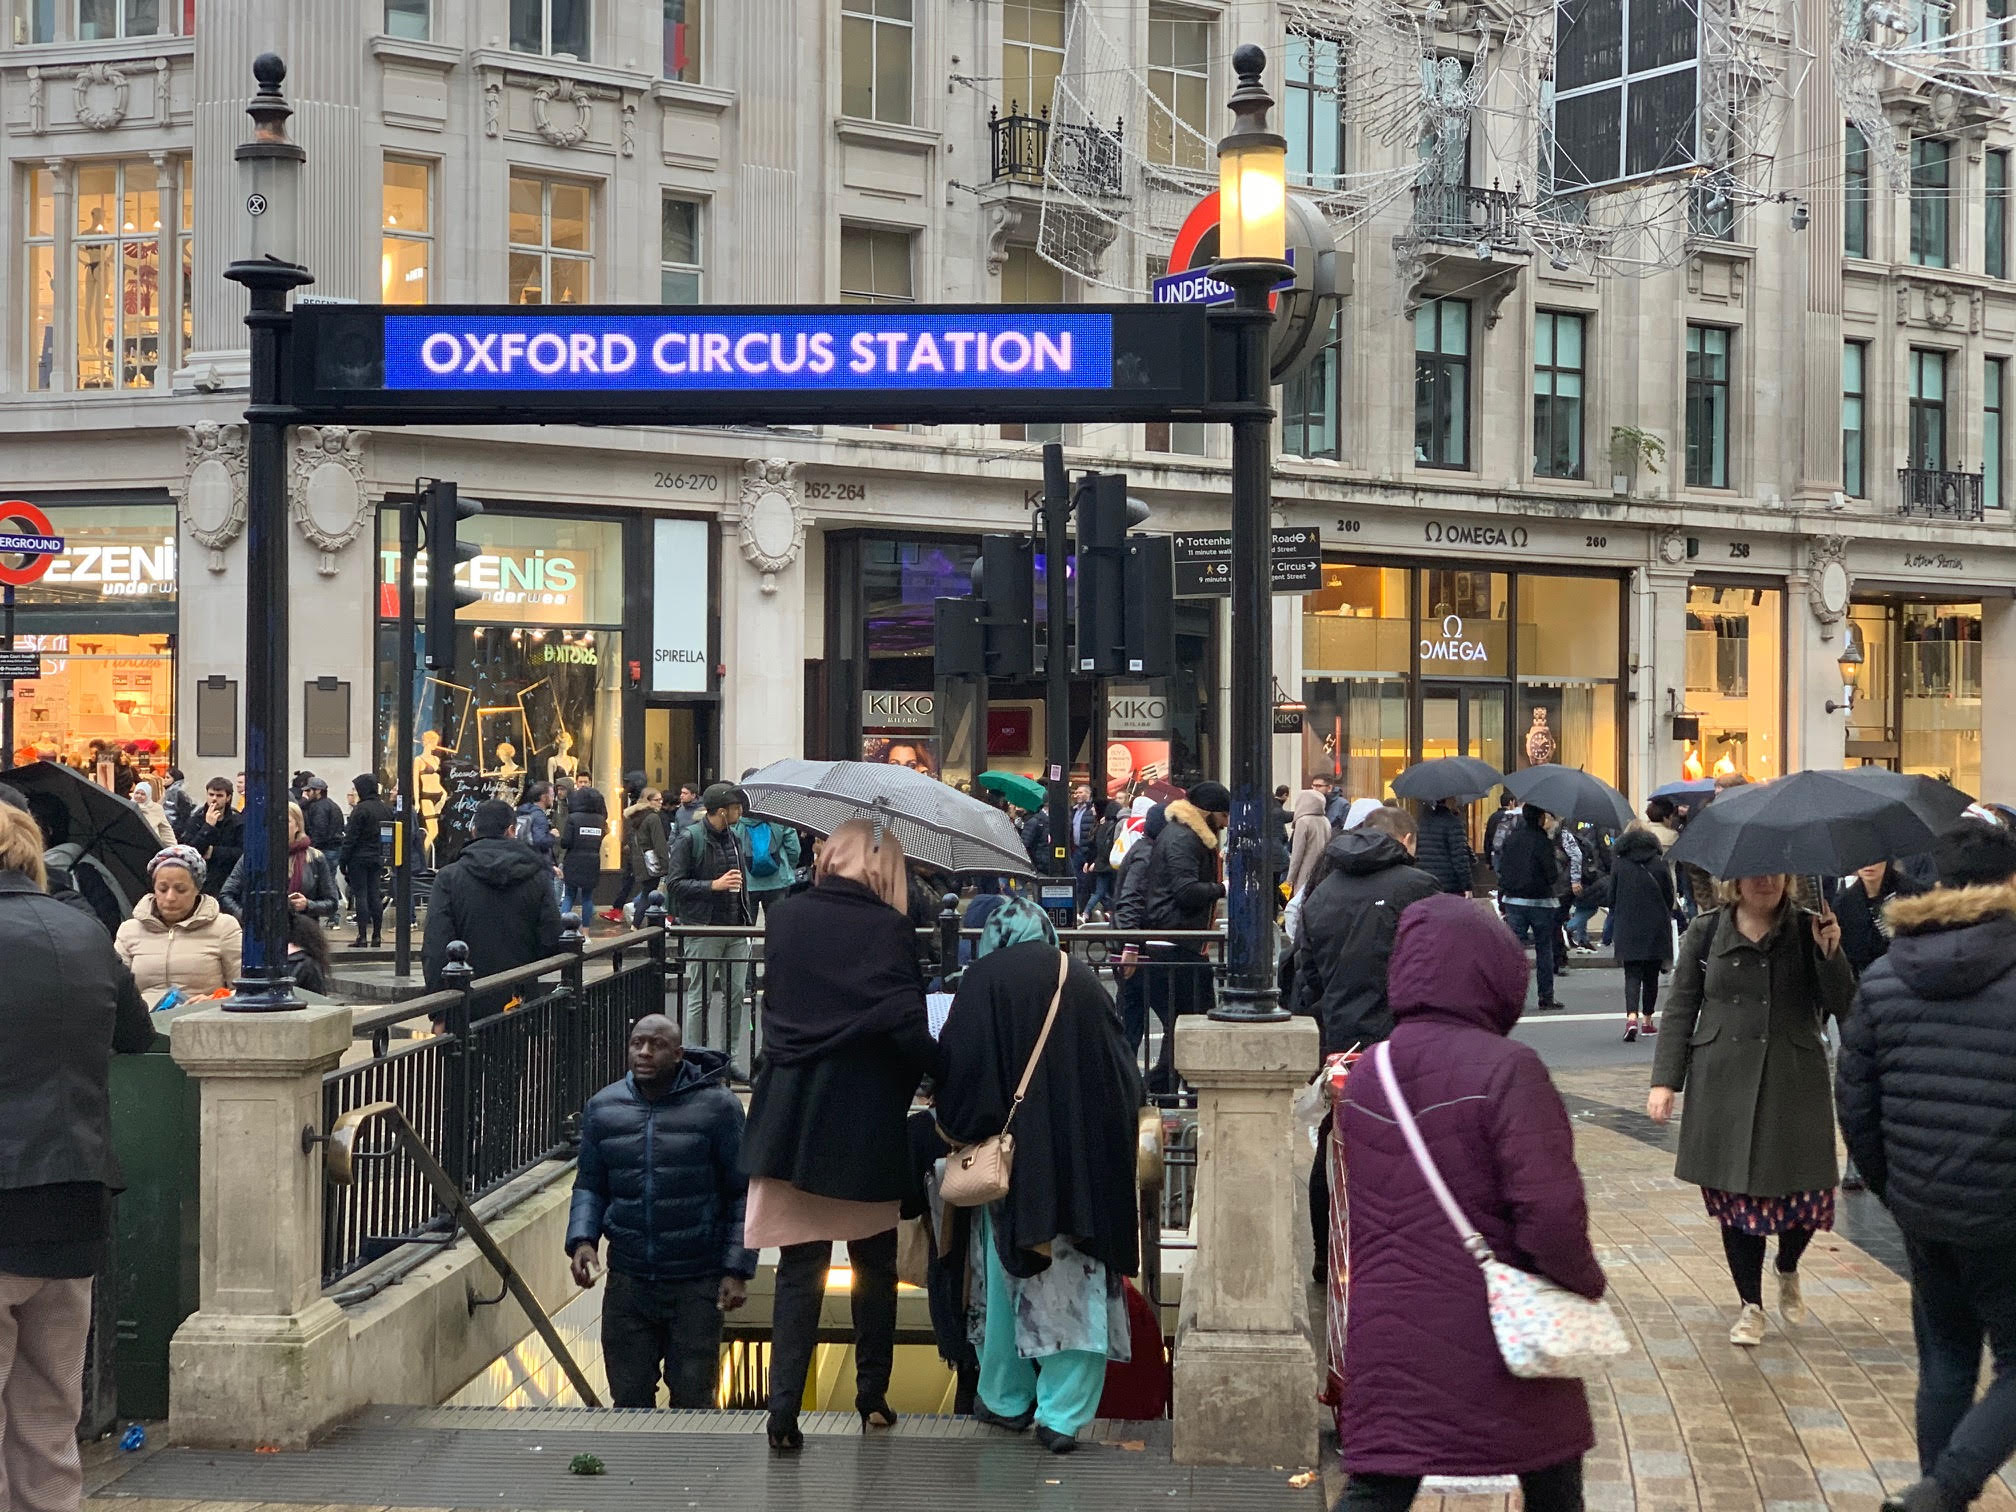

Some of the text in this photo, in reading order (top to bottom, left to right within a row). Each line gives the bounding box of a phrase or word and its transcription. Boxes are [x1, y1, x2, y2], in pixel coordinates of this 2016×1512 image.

[422, 331, 1073, 374] OXFORD CIRCUS STATION
[654, 472, 718, 491] 266-270
[805, 482, 866, 500] 262-264
[1337, 520, 1360, 532] 260
[1187, 533, 1295, 546] Tottenha Road
[1446, 525, 1507, 546] OMEGA
[1586, 536, 1607, 548] 260
[1729, 542, 1750, 558] 258
[1277, 562, 1306, 571] Circus
[655, 649, 705, 663] SPIRELLA
[1420, 640, 1488, 661] OMEGA
[869, 695, 933, 715] KIKO
[1108, 700, 1165, 719] KIKO
[1275, 713, 1300, 724] KIKO
